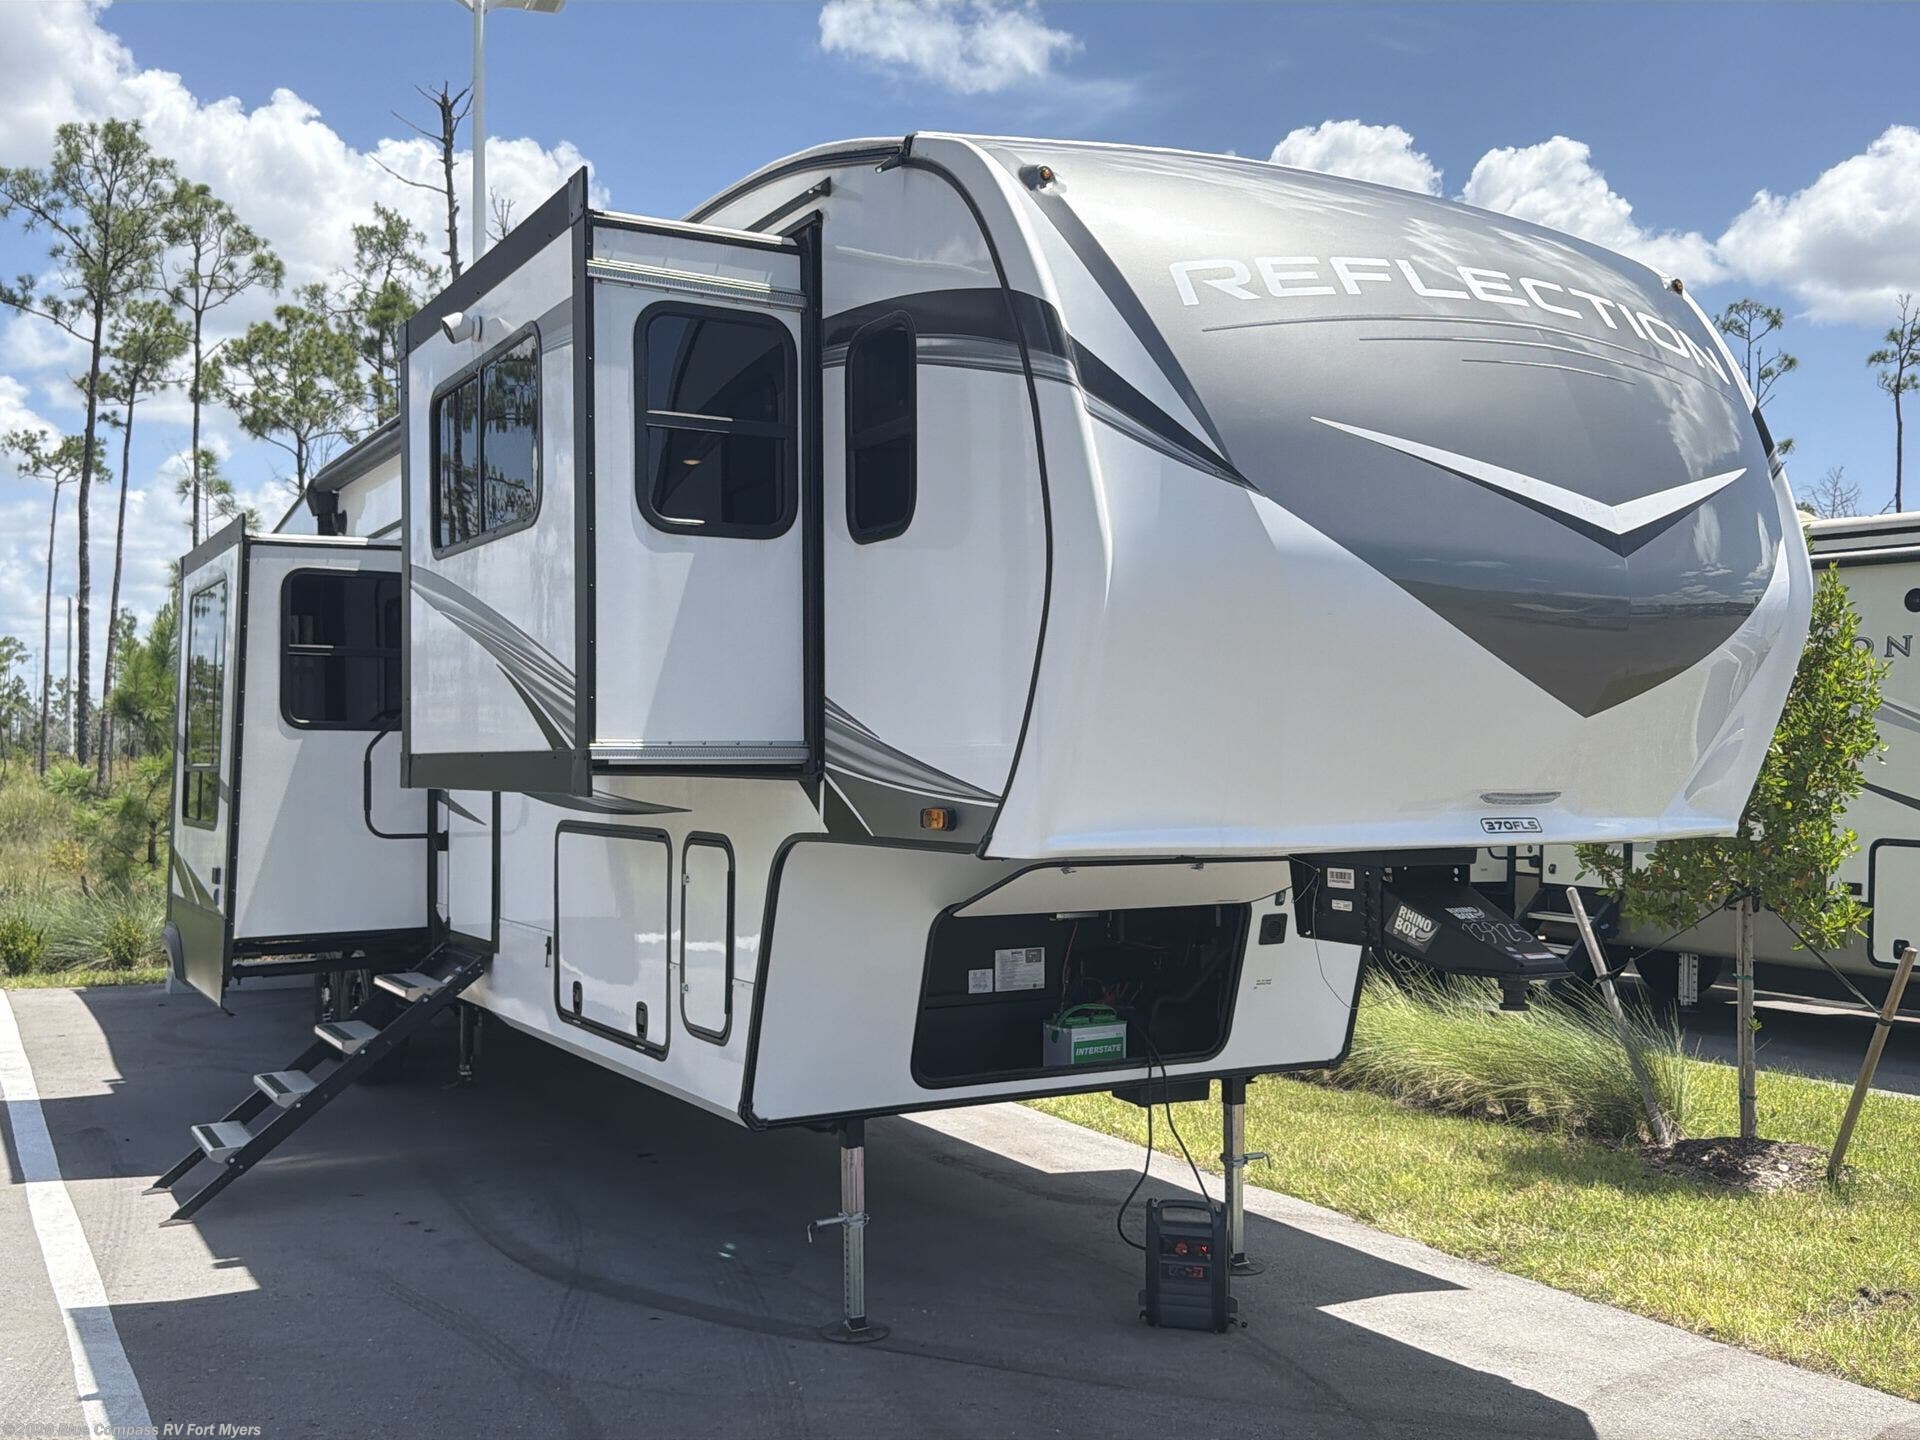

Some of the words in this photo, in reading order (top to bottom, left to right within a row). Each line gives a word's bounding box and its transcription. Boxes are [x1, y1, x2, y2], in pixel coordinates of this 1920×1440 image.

[1168, 255, 1731, 386] REFLECTION
[1484, 821, 1538, 831] 370FLS
[1394, 917, 1418, 939] BOX
[1398, 905, 1433, 932] RHINO
[1075, 1043, 1122, 1056] INTERSTATE
